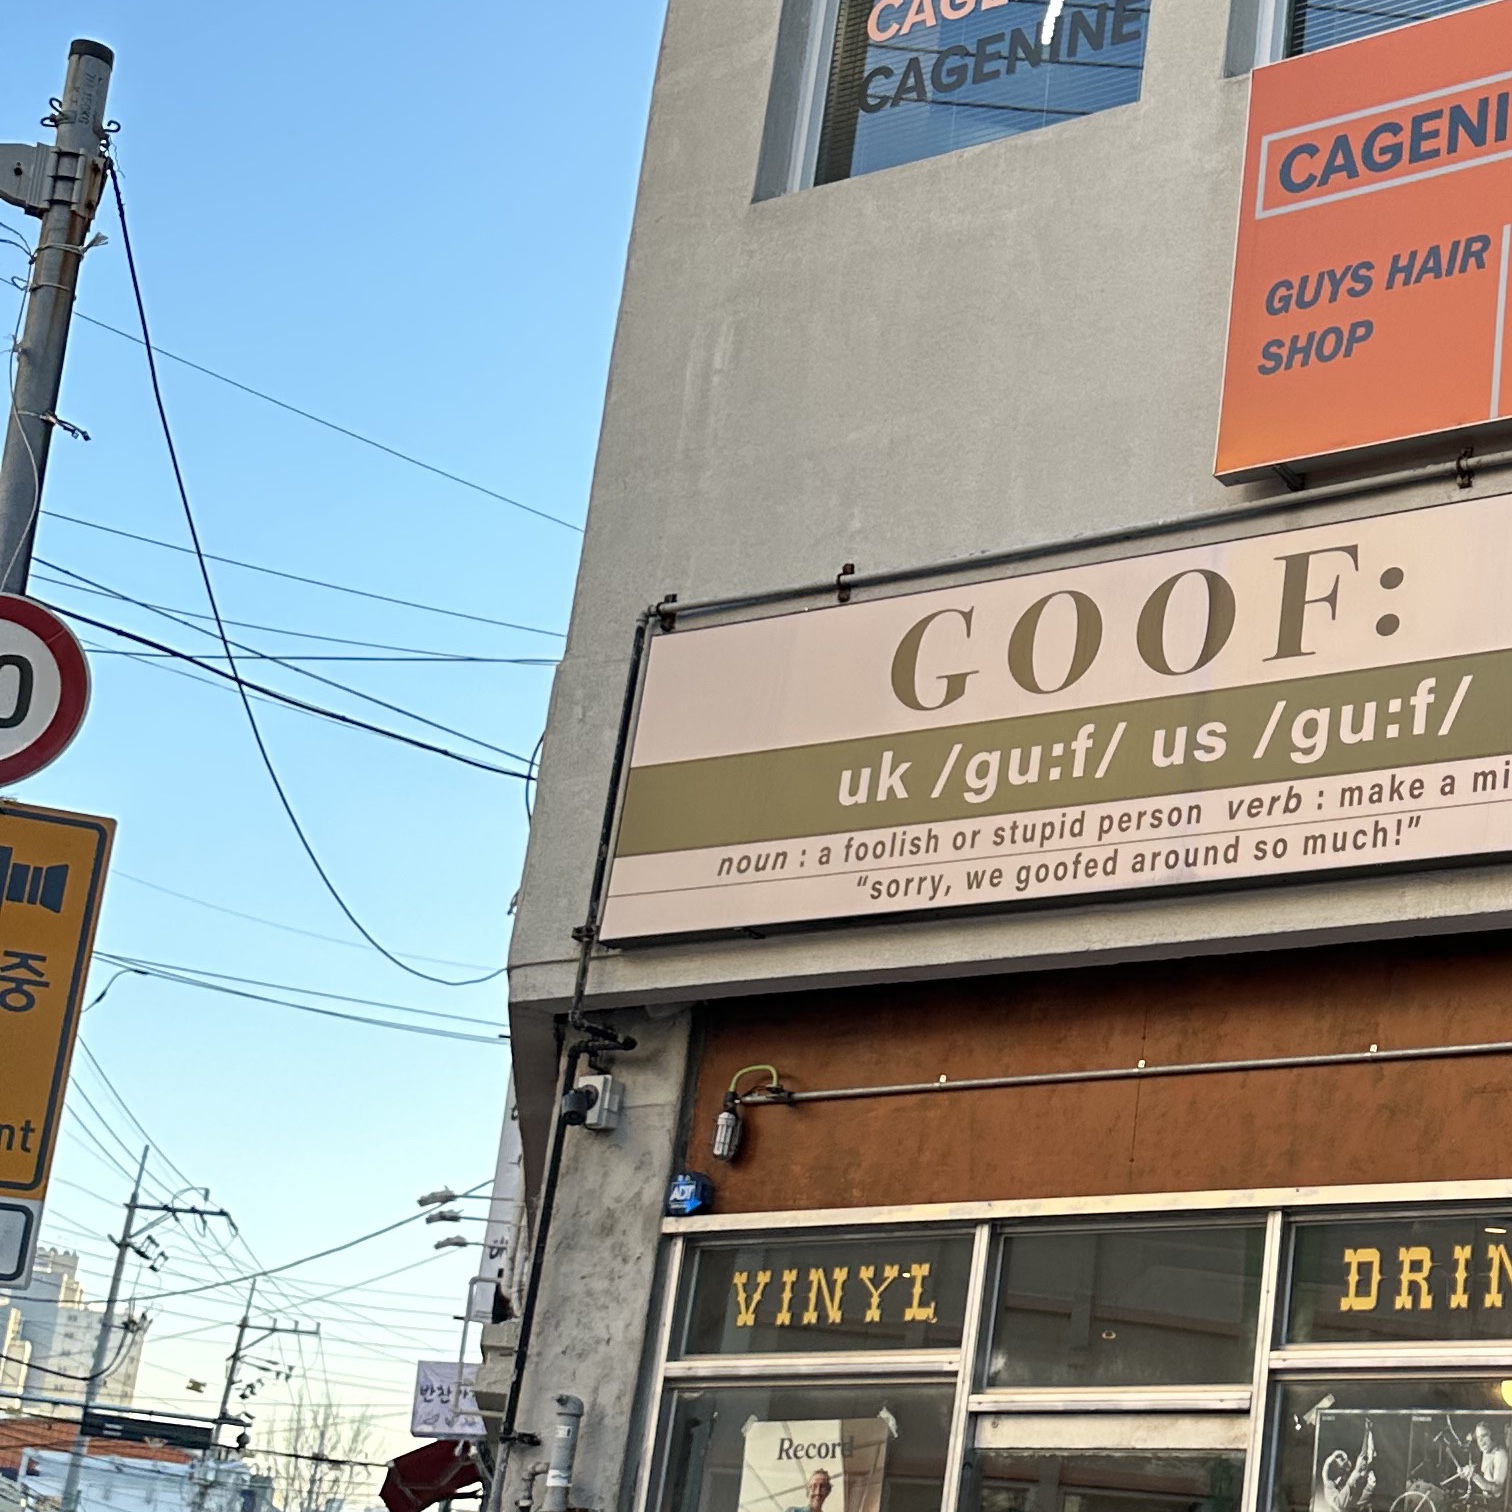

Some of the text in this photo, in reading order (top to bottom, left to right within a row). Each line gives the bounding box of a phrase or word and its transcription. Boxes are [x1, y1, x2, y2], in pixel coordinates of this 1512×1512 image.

[858, 0, 1142, 113] CAGENINE
[1265, 234, 1491, 316] GUYS HAIR
[1257, 319, 1373, 376] SHOP
[890, 544, 1405, 711] GOOF:
[837, 674, 1474, 807] uk /gu:f/ us /gu:f/
[717, 846, 787, 876] noun
[818, 846, 830, 866] a
[843, 828, 939, 863] foolish
[952, 827, 981, 852] or
[993, 811, 1085, 848] stupid
[1098, 803, 1202, 842] person
[1228, 785, 1302, 821] verb
[1339, 769, 1424, 808] make
[1440, 775, 1455, 797] a
[966, 867, 1003, 890] we
[1016, 849, 1118, 892] goofed
[1131, 835, 1239, 875] around
[1253, 838, 1288, 862] so
[733, 1262, 937, 1327] VINYL
[776, 1437, 855, 1461] Record
